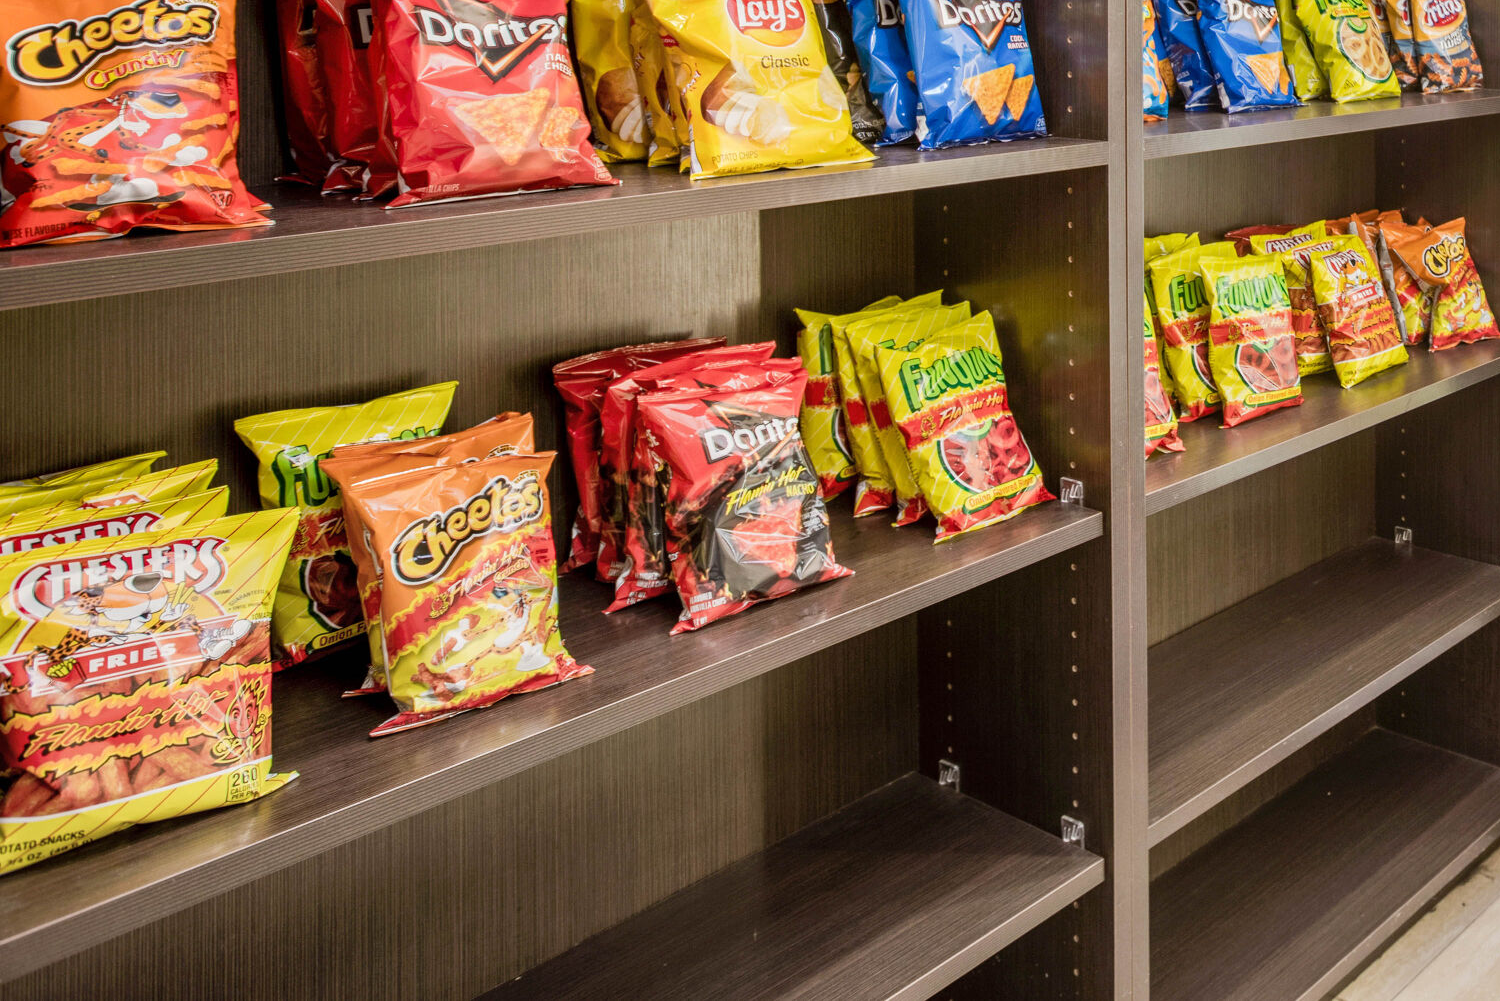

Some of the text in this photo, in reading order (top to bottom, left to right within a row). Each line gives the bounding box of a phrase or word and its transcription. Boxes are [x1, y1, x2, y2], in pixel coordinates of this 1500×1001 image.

[1010, 34, 1025, 43] COOL
[84, 49, 186, 90] Crunchy
[761, 52, 810, 70] Classic
[712, 149, 759, 165] POTATO CHIPS
[25, 222, 67, 238] FLAVORED
[1423, 235, 1466, 278] Cheetos
[1215, 272, 1291, 318] Funyuns
[900, 346, 1005, 413] Funyuns
[704, 414, 801, 464] Dorito
[726, 463, 807, 516] Flamin' Hot
[786, 482, 816, 497] NACHO
[394, 479, 542, 582] Cheetos
[16, 539, 223, 615] CHESTER'S
[318, 629, 354, 648] Onion
[88, 641, 179, 674] FRIES
[23, 689, 229, 758] Flamin' Hot
[232, 769, 259, 787] 260
[0, 840, 37, 855] OTATO
[40, 830, 86, 847] SNACKS
